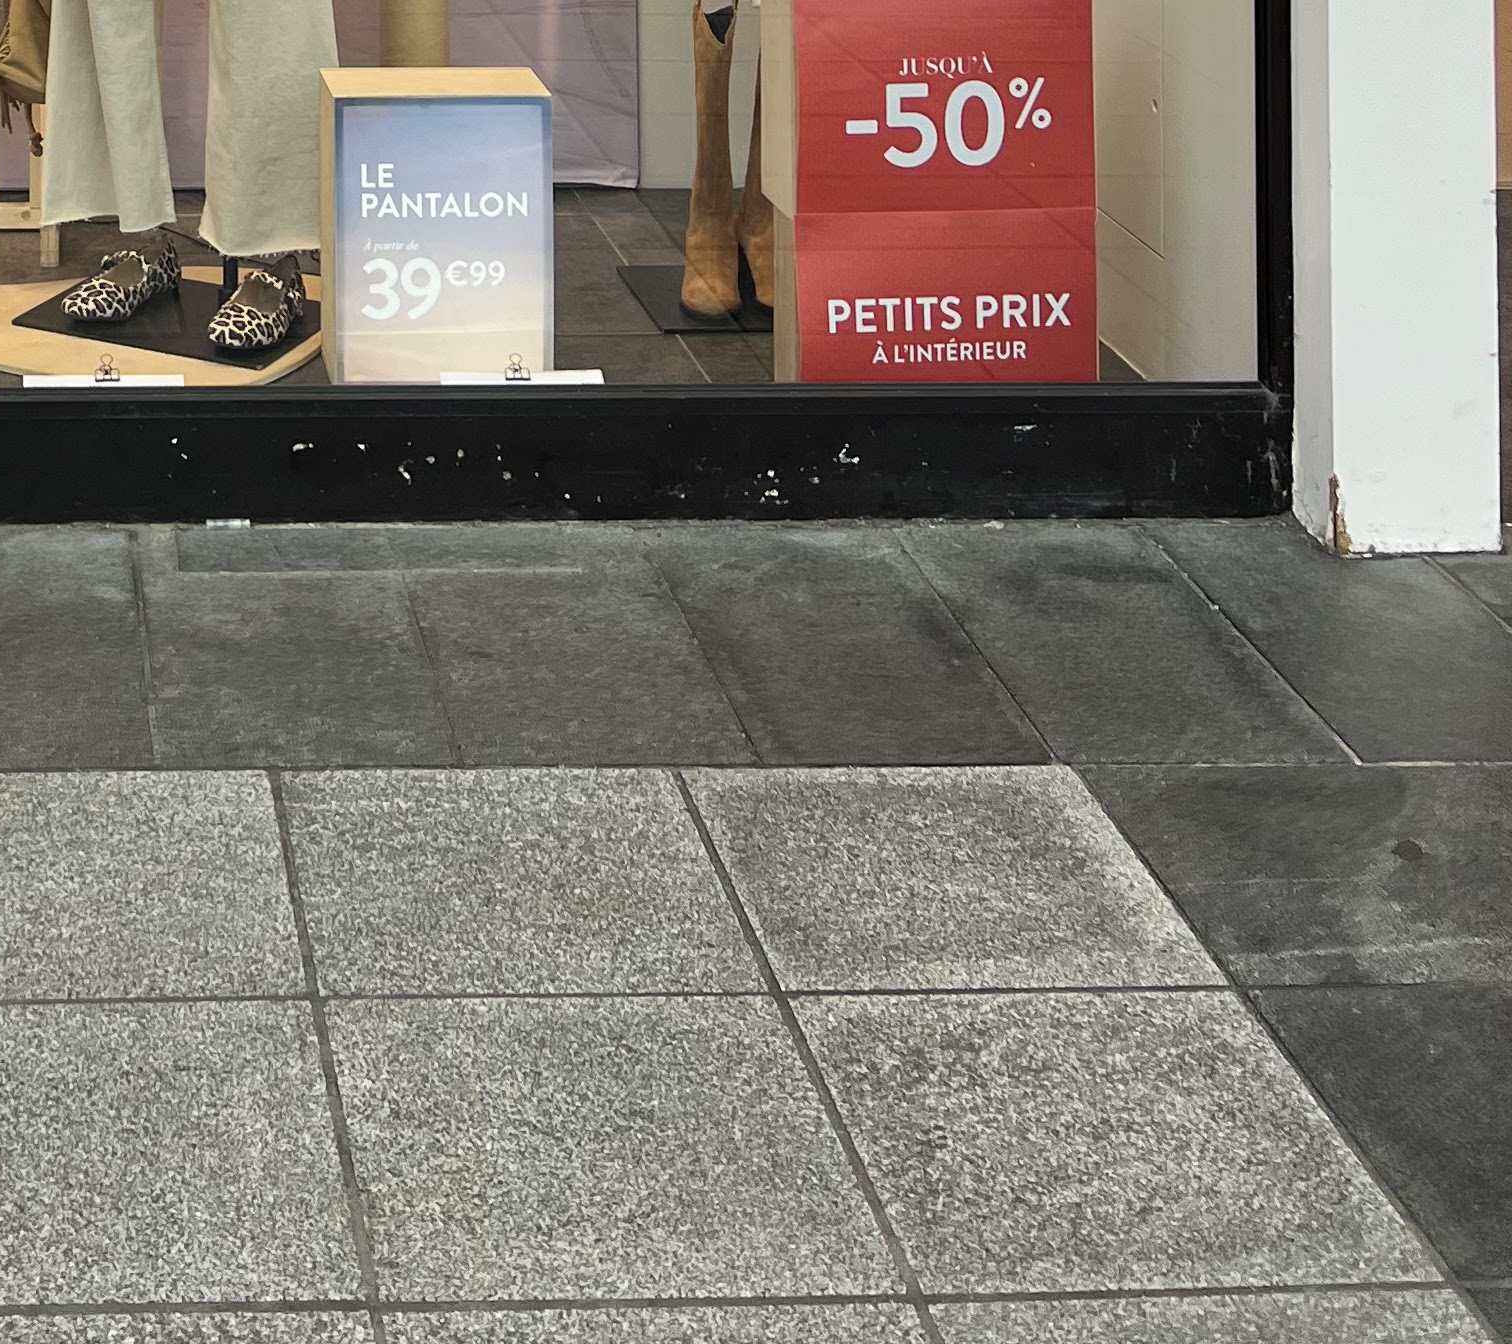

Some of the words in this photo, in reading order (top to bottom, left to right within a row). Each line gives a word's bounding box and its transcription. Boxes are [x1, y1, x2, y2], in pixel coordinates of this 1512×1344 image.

[899, 50, 994, 79] JUSQU'À
[845, 77, 1052, 169] -50%
[360, 163, 394, 188] LE
[361, 192, 528, 218] PANTALON
[373, 241, 404, 253] partir
[405, 239, 419, 251] de
[361, 257, 506, 321] 39€99
[828, 296, 963, 334] PETITS
[976, 293, 1071, 329] PRIX
[872, 340, 889, 364] À
[894, 337, 1027, 364] L'INTÉRIEUR
